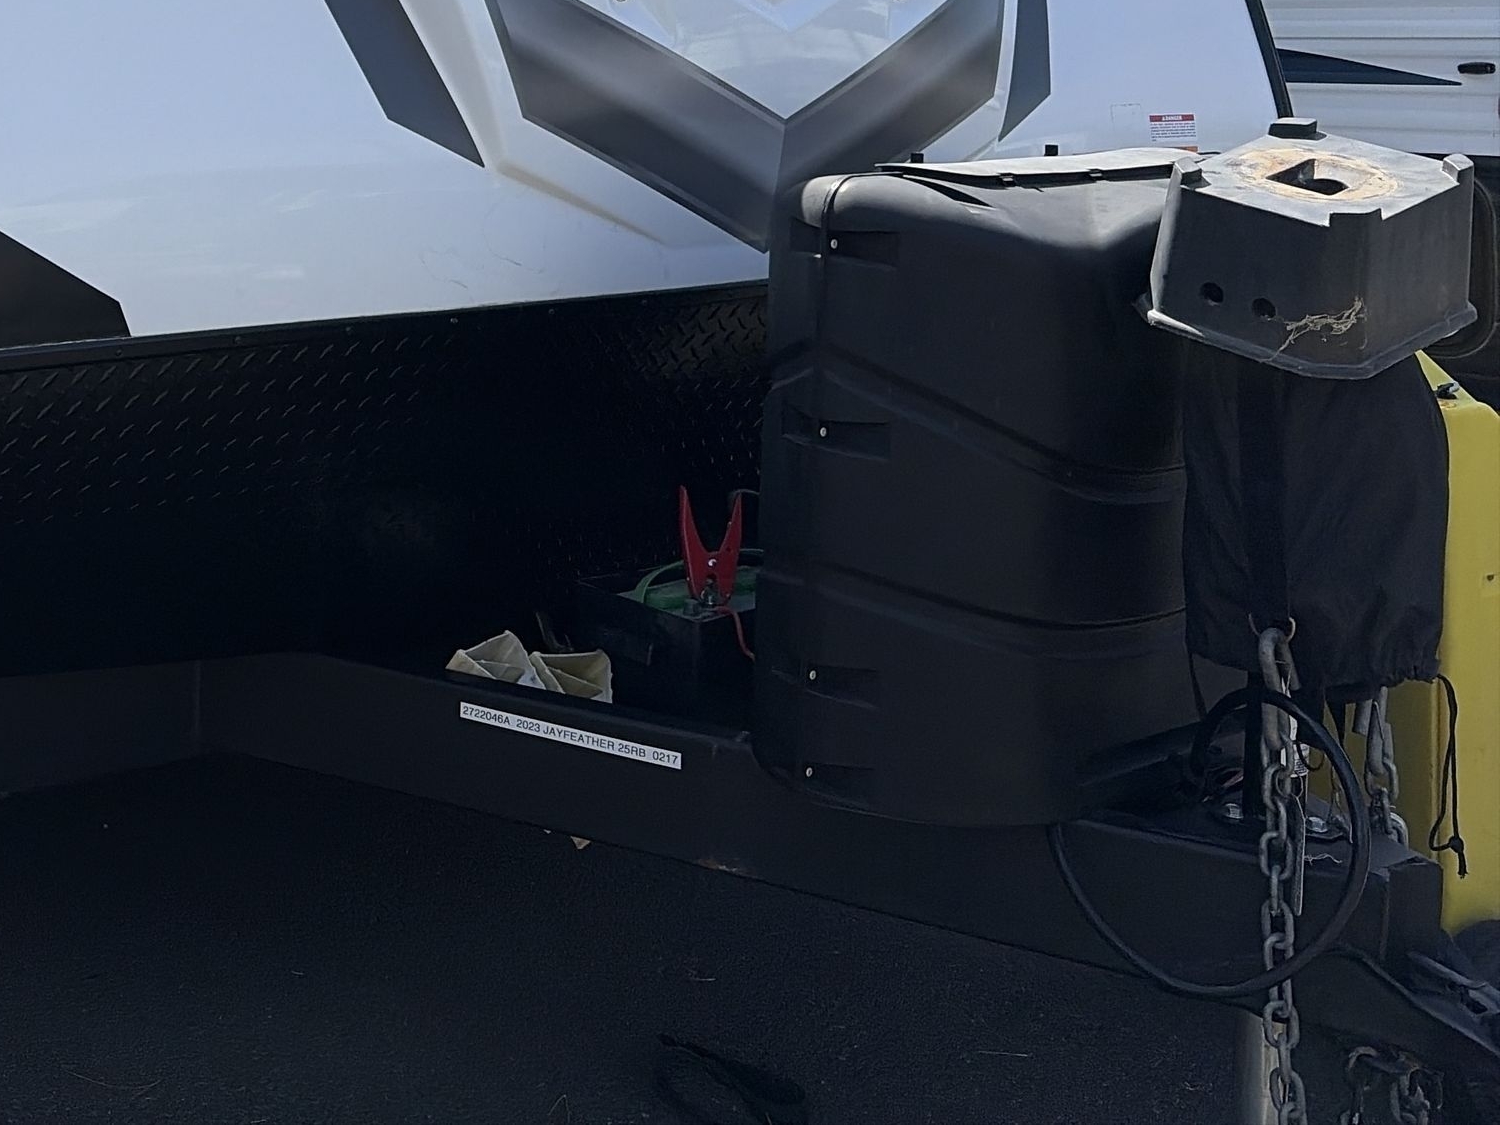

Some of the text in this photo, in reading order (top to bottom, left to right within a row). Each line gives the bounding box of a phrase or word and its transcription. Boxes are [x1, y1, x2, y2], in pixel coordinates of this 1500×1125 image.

[462, 705, 679, 765] 2722046A 2023 JAYFEATHER 25RB 0217
